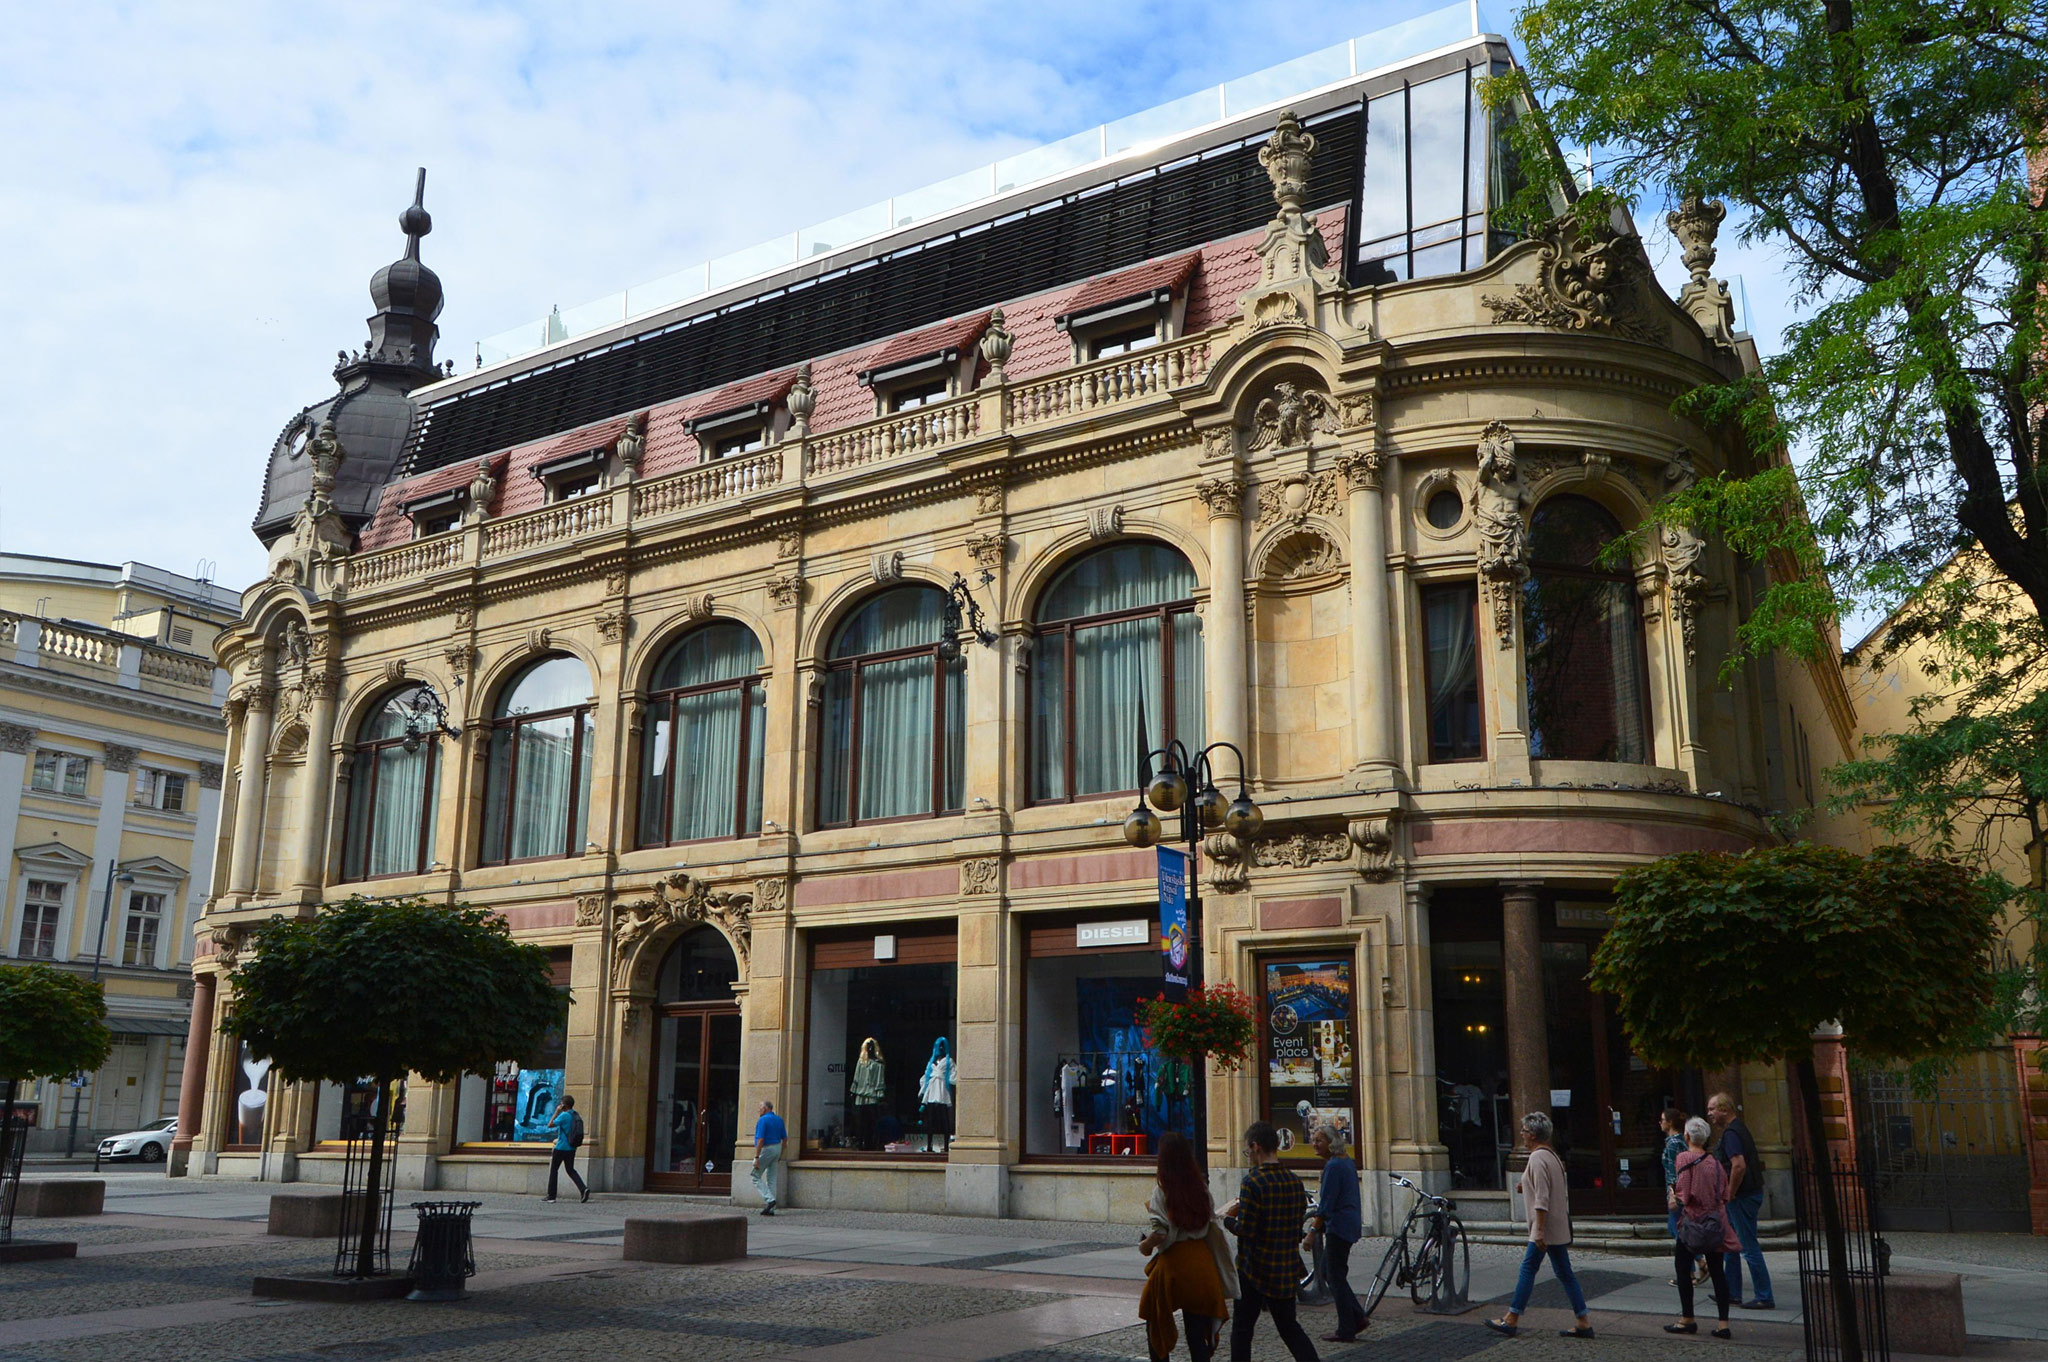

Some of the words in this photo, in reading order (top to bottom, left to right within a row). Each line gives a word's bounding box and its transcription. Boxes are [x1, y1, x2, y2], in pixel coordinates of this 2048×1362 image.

[1081, 926, 1144, 940] DIESEL
[1273, 1036, 1303, 1048] Event
[1276, 1047, 1309, 1060] place
